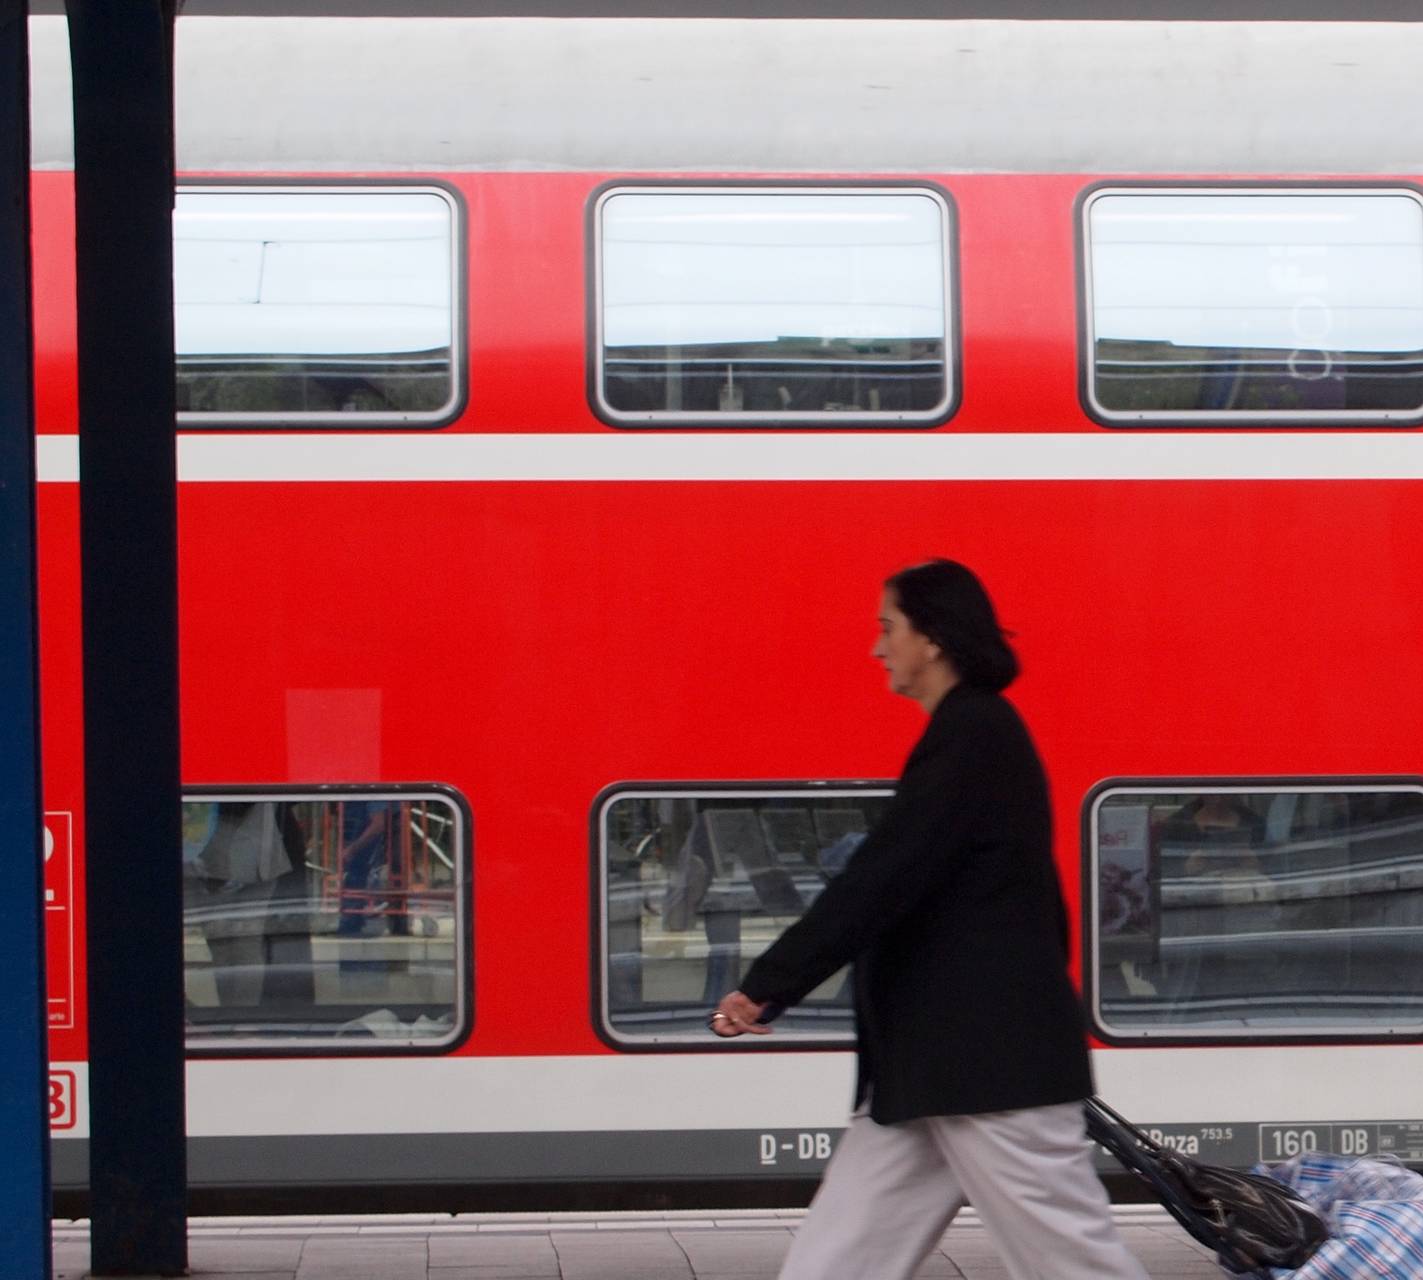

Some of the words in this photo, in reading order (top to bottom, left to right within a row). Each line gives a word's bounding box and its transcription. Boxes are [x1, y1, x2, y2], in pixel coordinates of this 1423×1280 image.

[1201, 1128, 1233, 1140] 753.5
[1272, 1129, 1317, 1157] 160
[1341, 1129, 1369, 1155] DB
